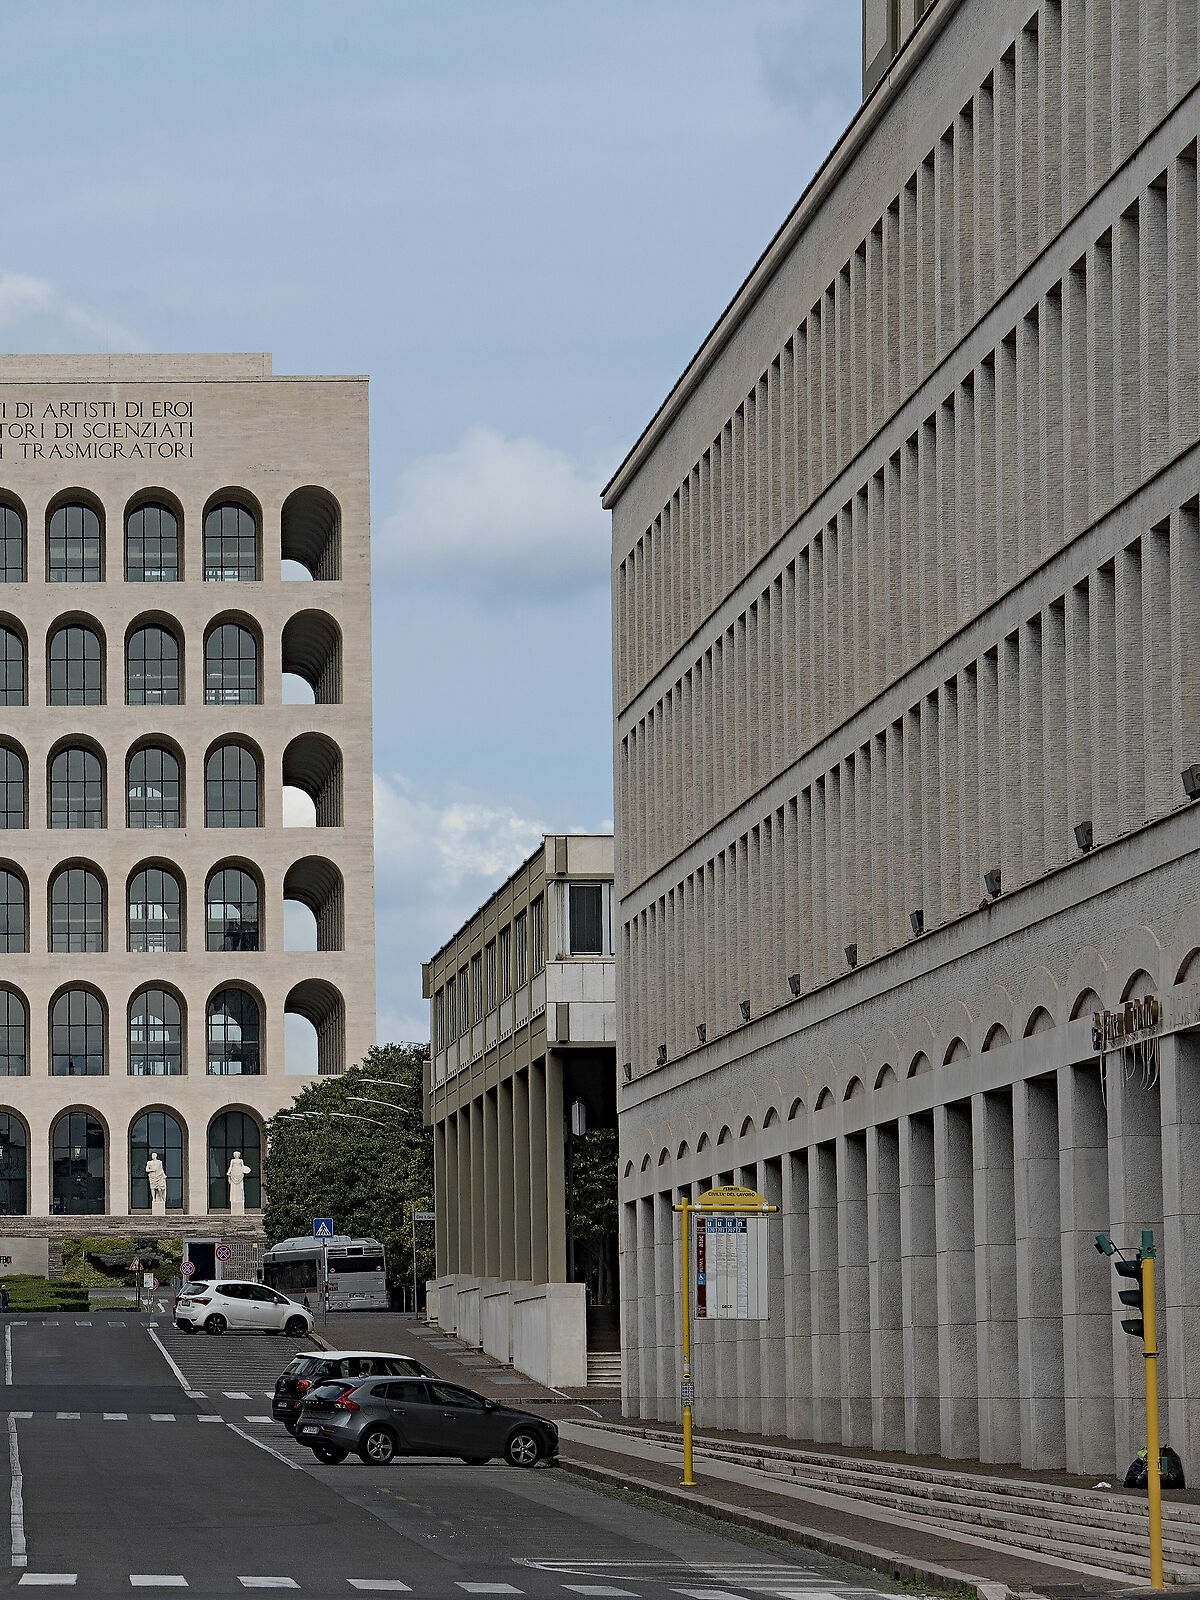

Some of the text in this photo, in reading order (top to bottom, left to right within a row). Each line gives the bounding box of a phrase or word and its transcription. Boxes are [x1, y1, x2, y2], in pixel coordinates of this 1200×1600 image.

[15, 402, 33, 419] DI
[42, 402, 116, 418] ARTISTI
[124, 401, 143, 418] DI
[152, 401, 193, 418] EROI
[54, 422, 73, 439] DI
[82, 421, 193, 438] SCIENZIATI
[18, 442, 193, 459] TRASMIGRATORI
